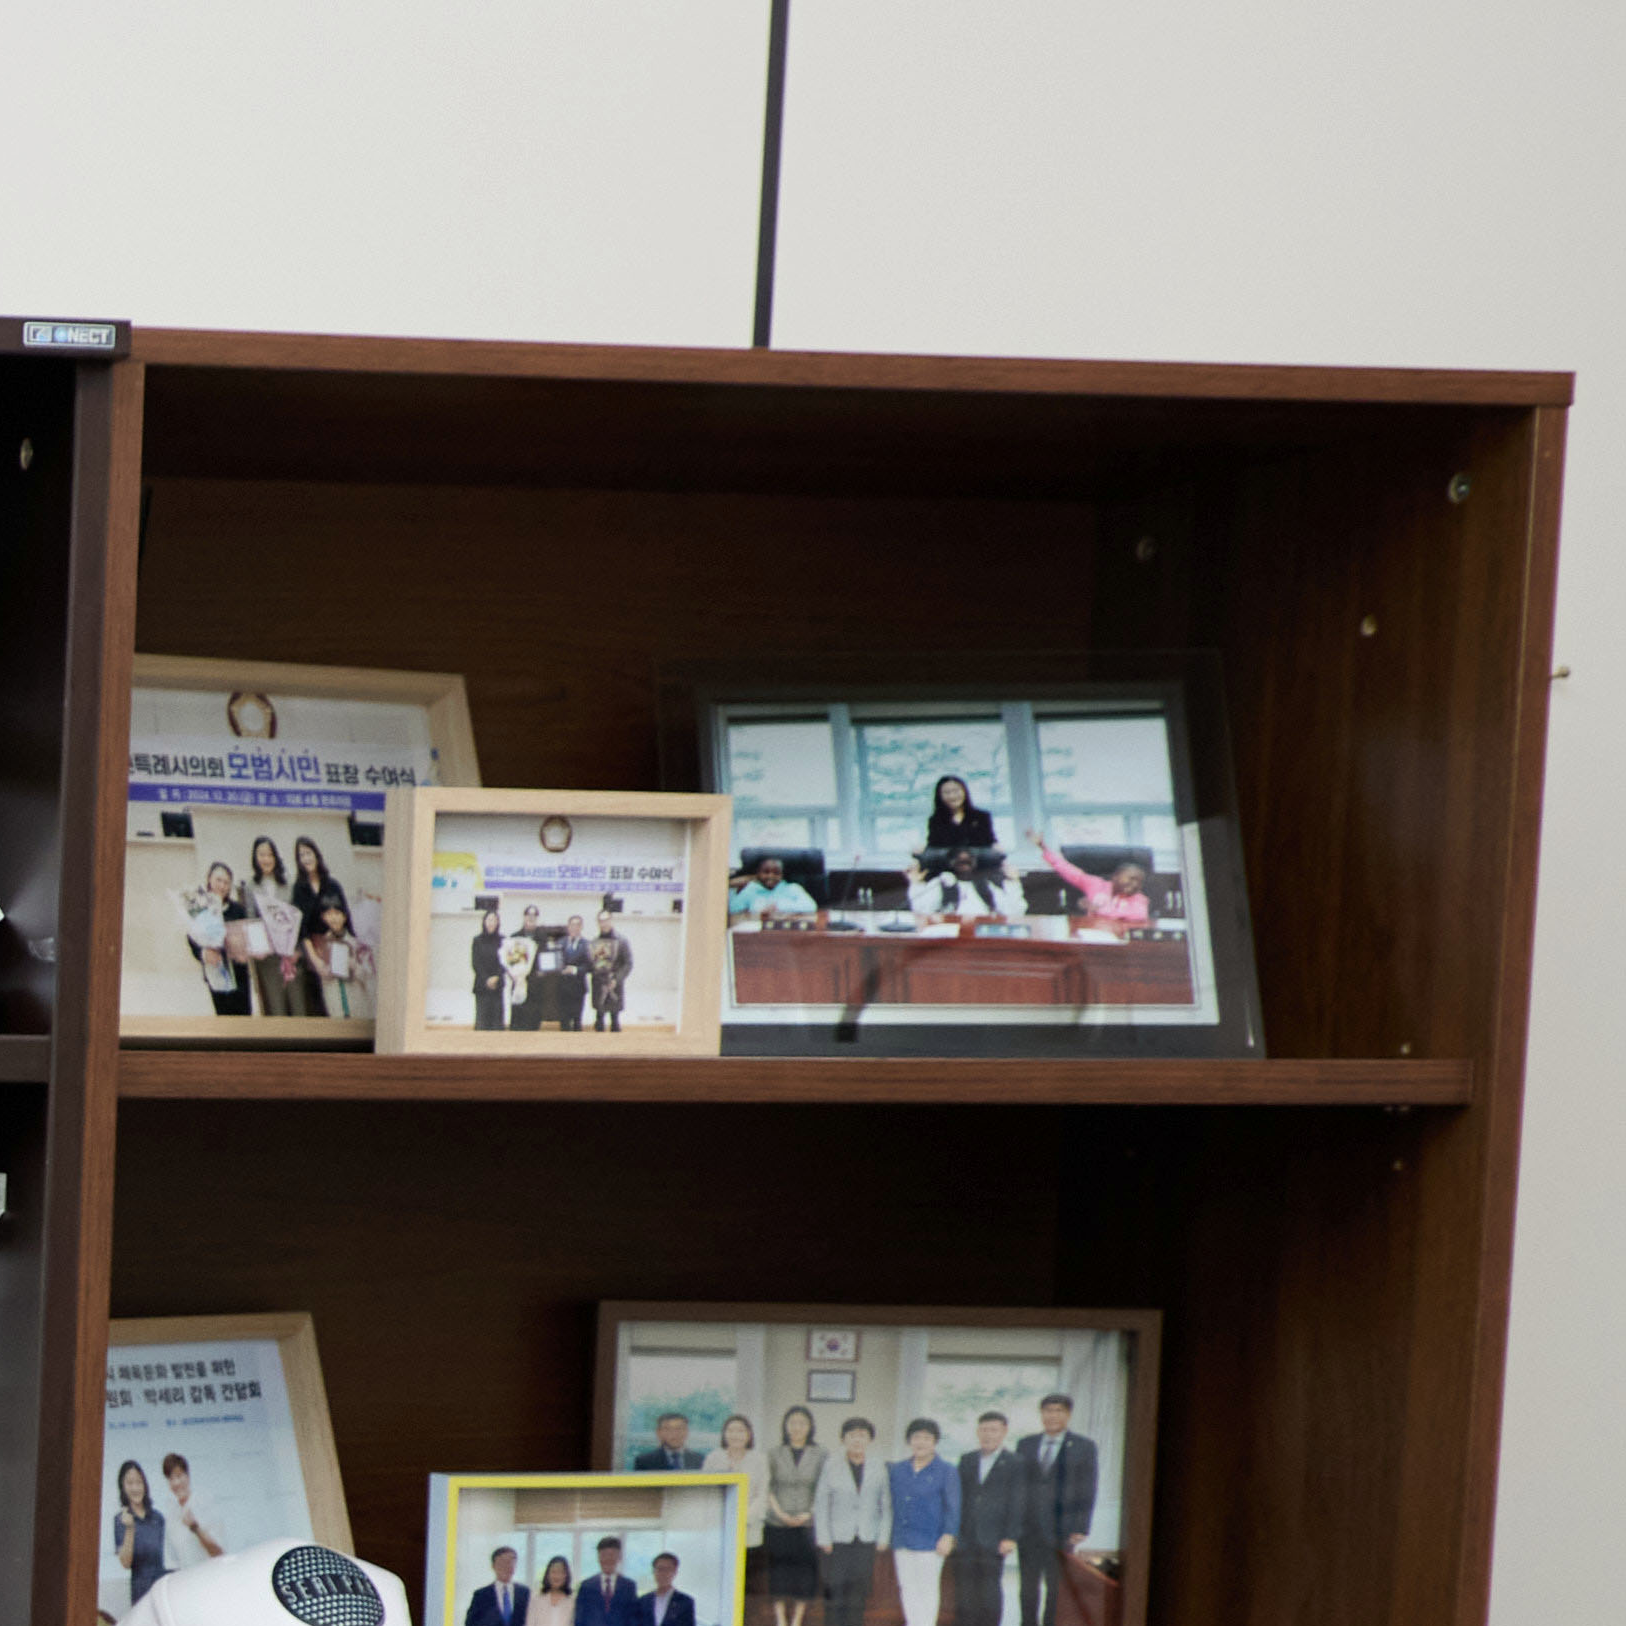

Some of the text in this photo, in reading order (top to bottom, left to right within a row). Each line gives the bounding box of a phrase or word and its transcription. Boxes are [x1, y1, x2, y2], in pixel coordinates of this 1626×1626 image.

[128, 754, 225, 778] 특례시의회
[228, 751, 322, 784] 모범시민
[365, 765, 417, 789] 수여식
